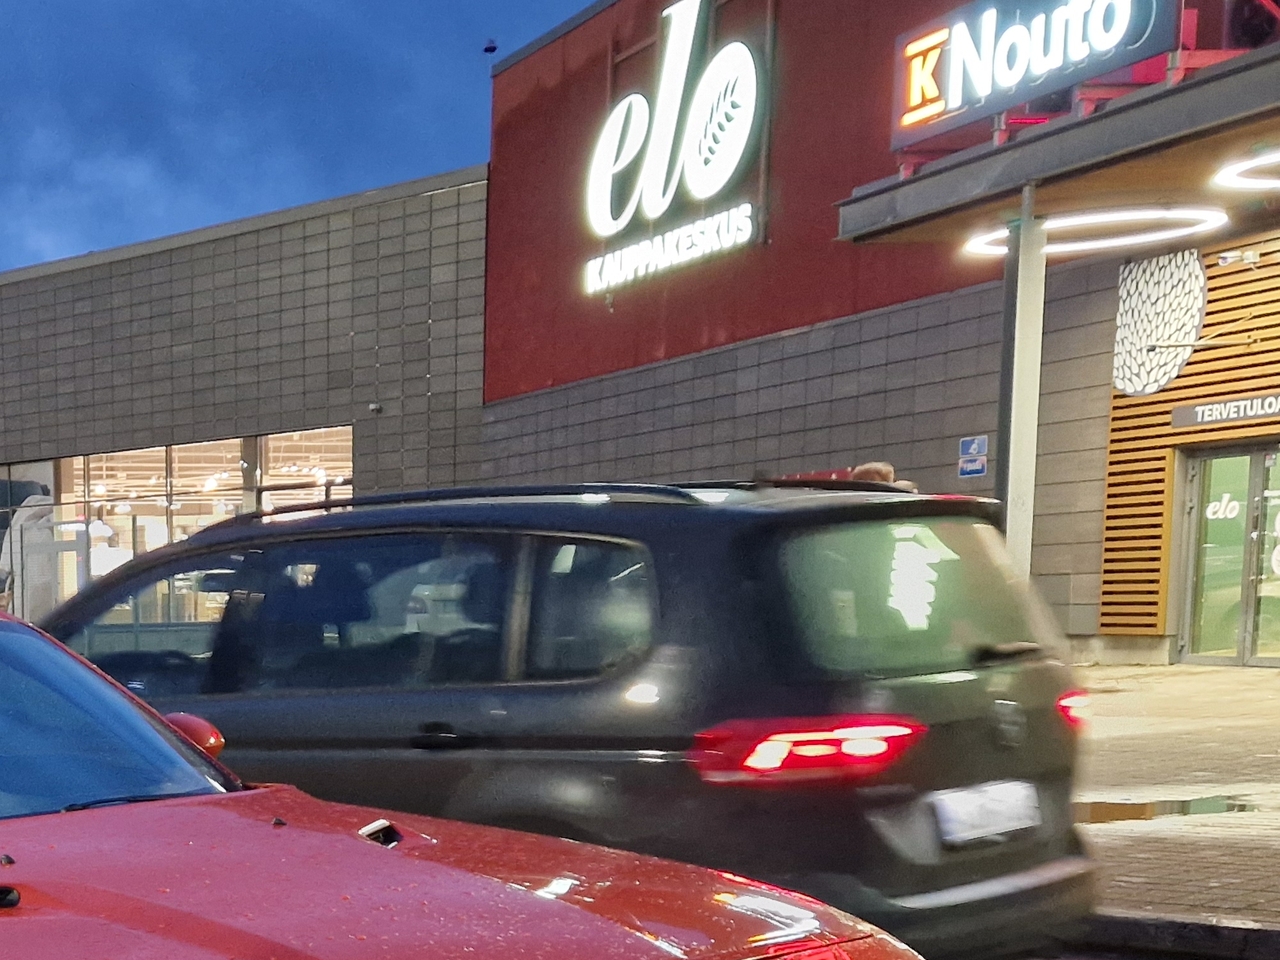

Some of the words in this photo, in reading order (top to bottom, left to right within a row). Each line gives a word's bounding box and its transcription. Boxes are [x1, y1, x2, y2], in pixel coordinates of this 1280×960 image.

[587, 0, 757, 237] elo
[586, 203, 752, 294] KAUPPAKESKUS
[1206, 493, 1239, 519] elo
